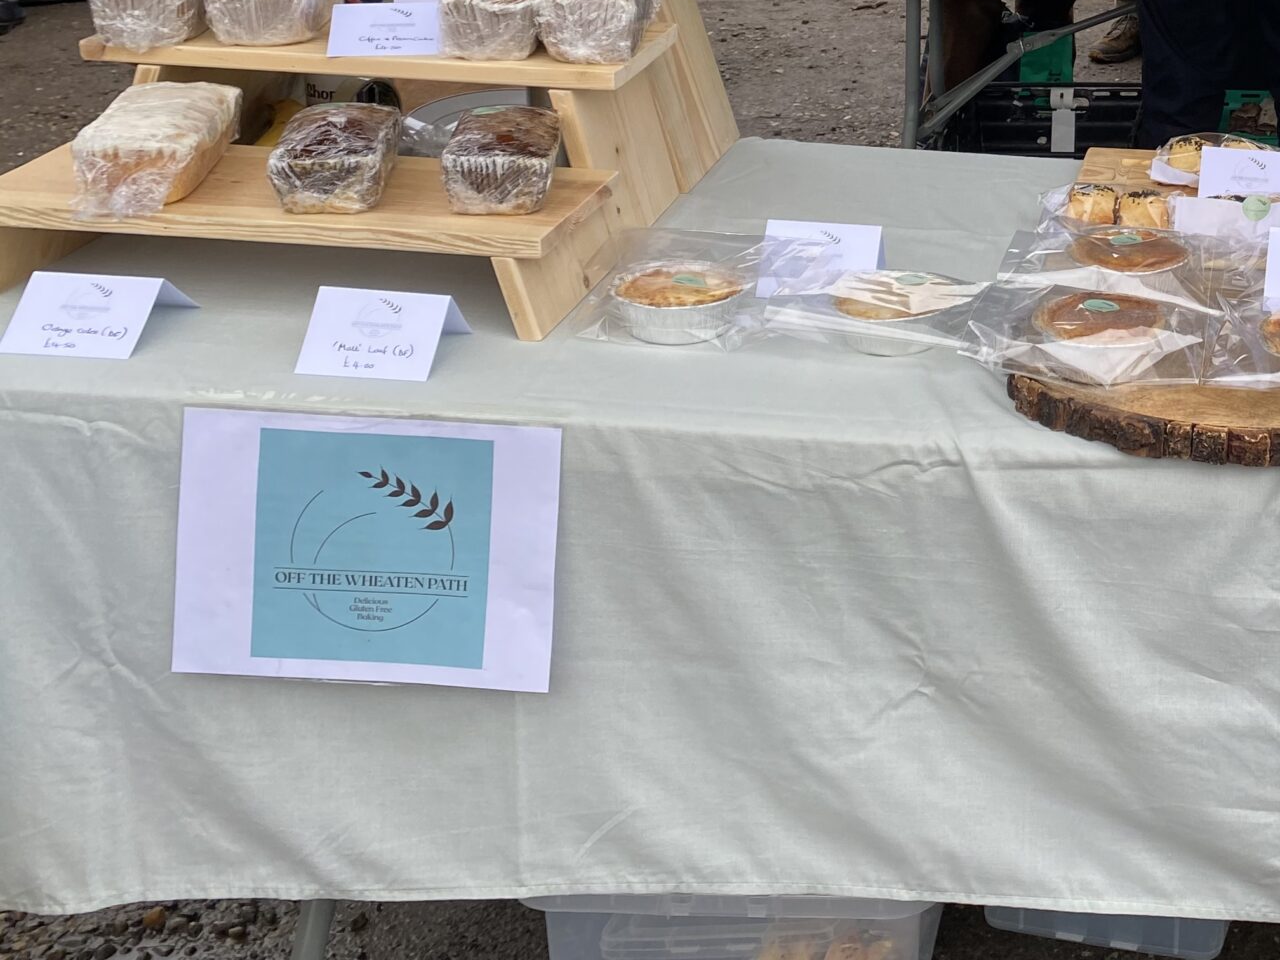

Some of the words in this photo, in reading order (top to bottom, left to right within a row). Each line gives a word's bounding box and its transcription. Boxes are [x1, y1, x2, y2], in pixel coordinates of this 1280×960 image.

[367, 345, 388, 355] Loaf
[275, 571, 305, 584] OFF
[309, 572, 342, 586] THE
[345, 574, 425, 589] WHEATEN
[427, 578, 468, 592] PATH
[354, 597, 388, 605] Delicious
[349, 605, 375, 613] Gluten
[376, 606, 393, 614] Free
[356, 613, 384, 622] Baking
